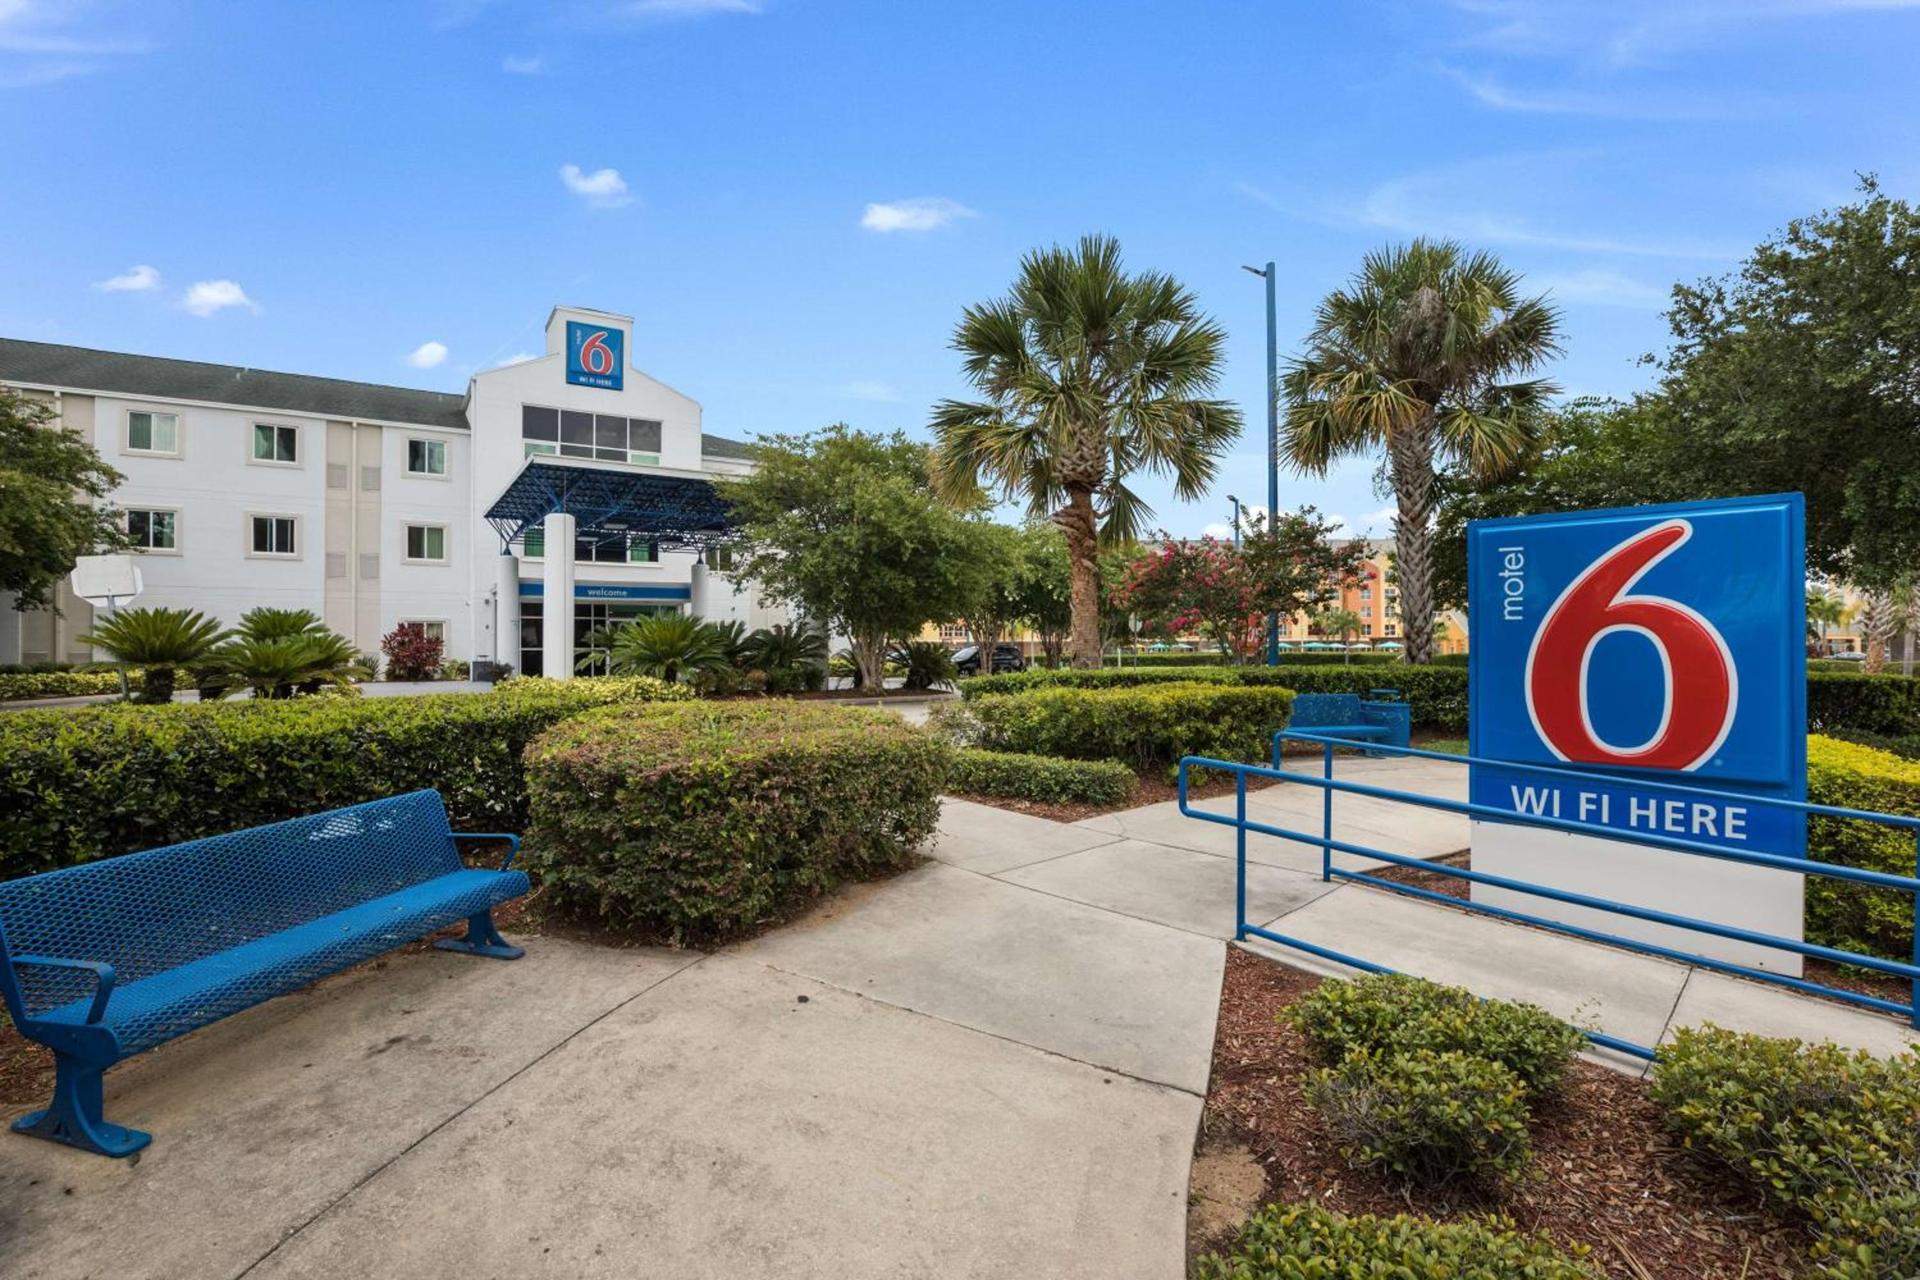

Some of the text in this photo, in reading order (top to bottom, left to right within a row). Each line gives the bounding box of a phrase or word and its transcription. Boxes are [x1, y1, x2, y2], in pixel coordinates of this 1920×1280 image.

[581, 331, 613, 375] 6
[587, 587, 628, 597] welcome
[1498, 518, 1739, 772] motel 6
[1510, 785, 1748, 841] WI FI HERE
